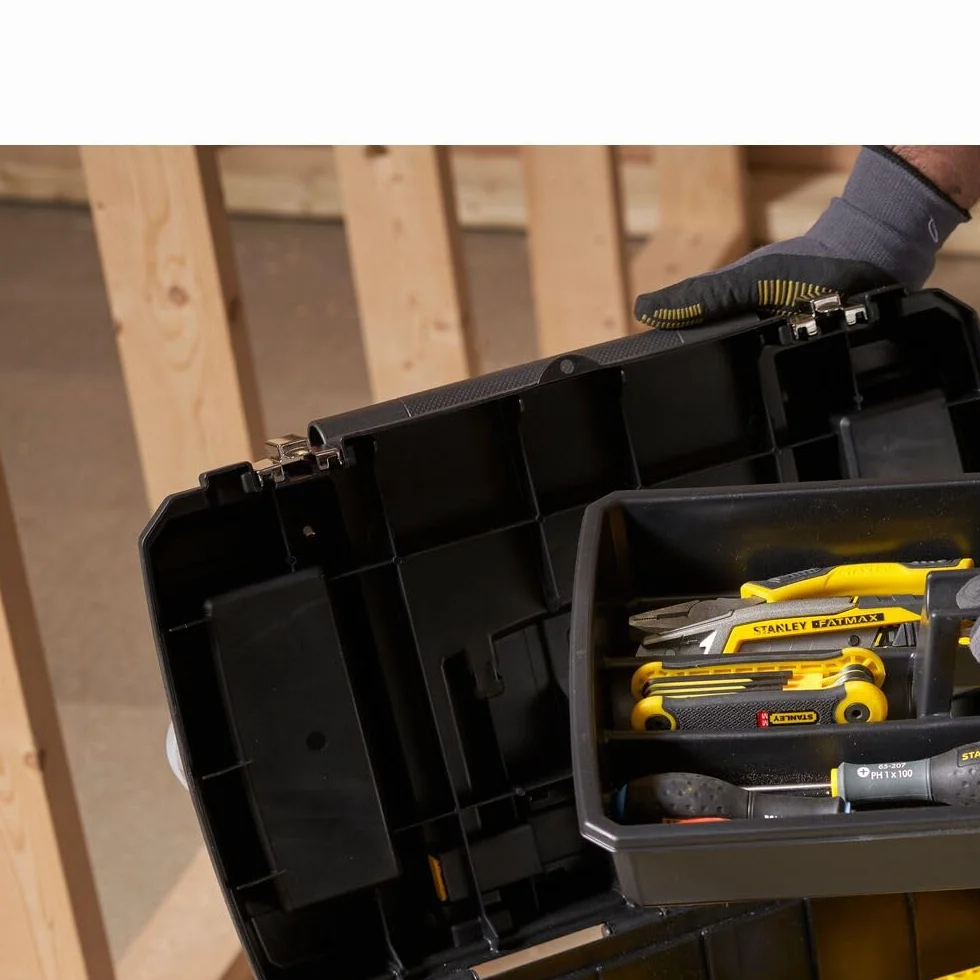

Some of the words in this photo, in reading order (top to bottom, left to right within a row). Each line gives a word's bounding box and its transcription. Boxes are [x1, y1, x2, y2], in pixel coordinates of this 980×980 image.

[753, 621, 807, 635] STANLEY
[819, 614, 878, 628] FATMAX
[773, 713, 814, 722] STANLEY
[871, 770, 883, 780] PH
[898, 769, 913, 778] 100
